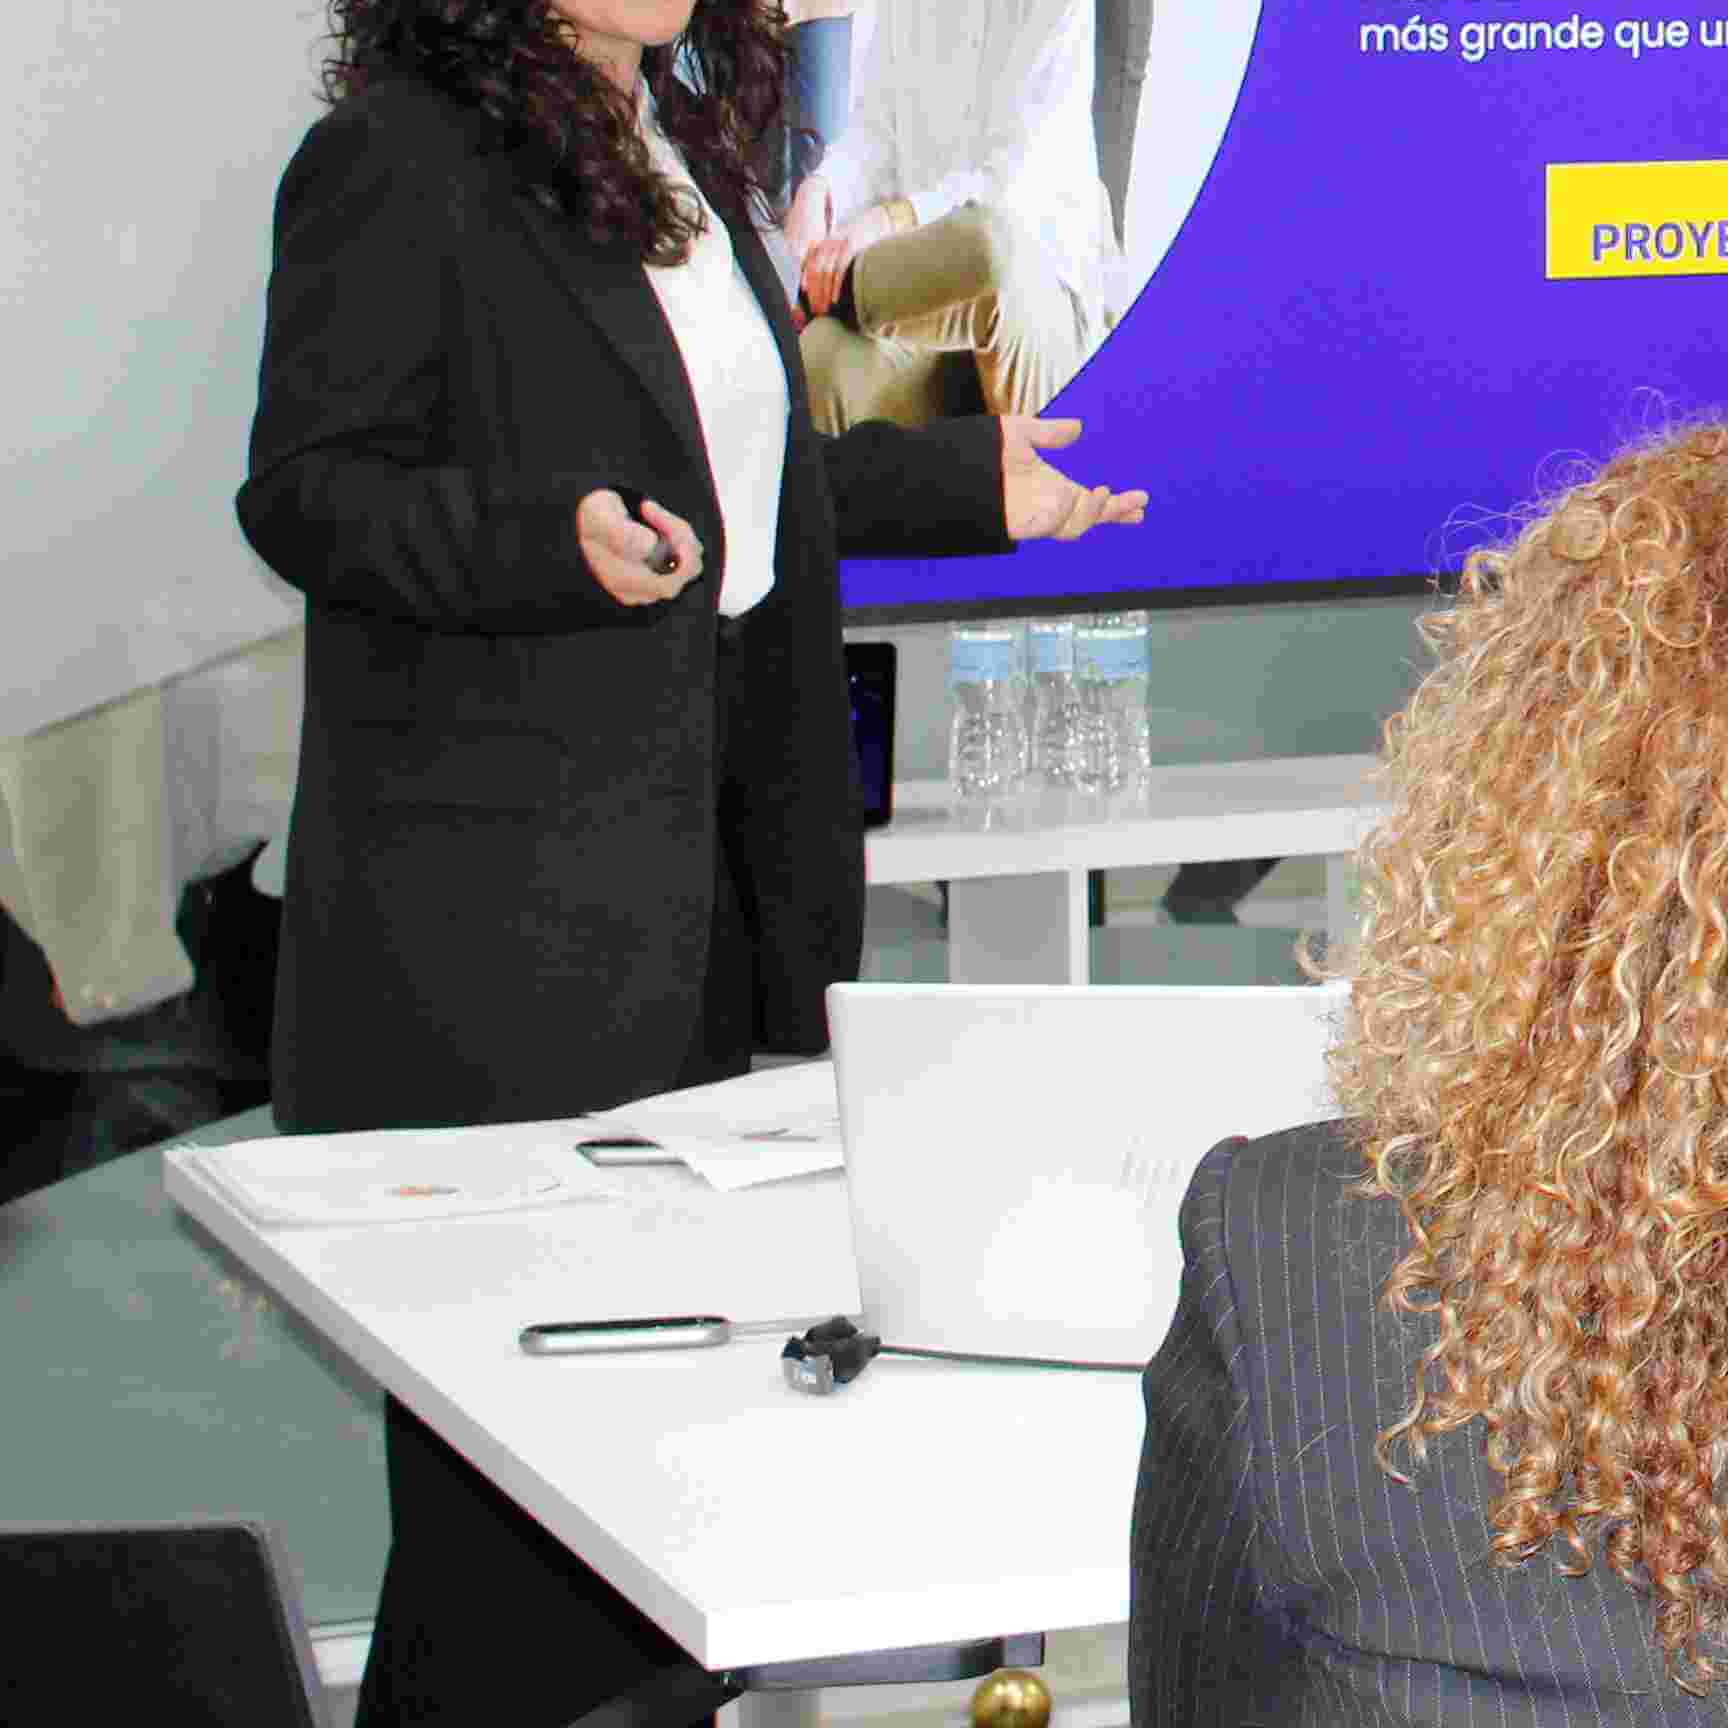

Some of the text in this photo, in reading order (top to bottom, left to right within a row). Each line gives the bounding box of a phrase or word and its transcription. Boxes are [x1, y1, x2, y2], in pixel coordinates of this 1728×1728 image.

[1359, 14, 1449, 52] más
[1459, 13, 1605, 63] grande
[1614, 20, 1690, 59] que
